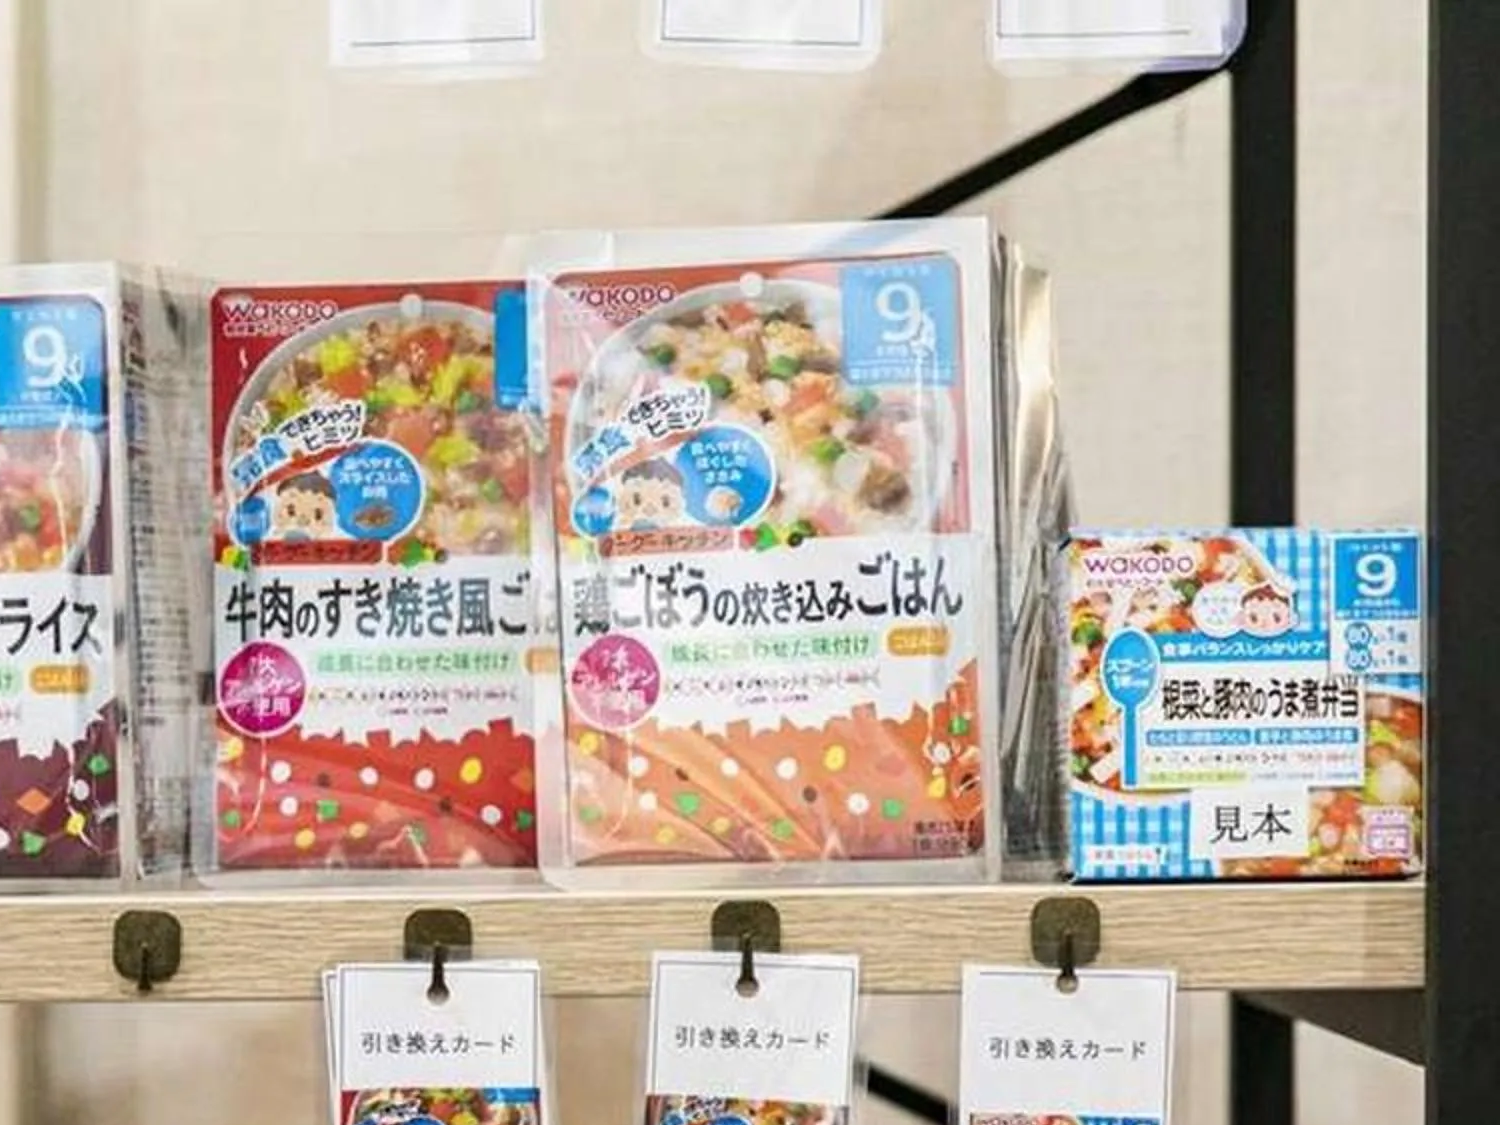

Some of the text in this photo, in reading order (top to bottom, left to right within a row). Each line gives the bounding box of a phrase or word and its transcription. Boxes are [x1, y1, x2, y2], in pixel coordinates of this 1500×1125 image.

[877, 282, 921, 344] 9
[23, 326, 65, 387] 9
[280, 406, 362, 440] できちゃう!
[573, 553, 963, 635] 鶏ごぼうの炊き込みごはん
[1355, 553, 1398, 597] 9
[225, 572, 557, 641] 牛肉のすき焼き風ご
[1162, 641, 1328, 658] 食事バランスしっかりケア
[1161, 674, 1360, 720] 根菜と豚肉のうま煮弁当
[1209, 803, 1293, 844] 見本
[361, 1031, 515, 1056] 引き換えカード
[675, 1026, 831, 1051] 引き換えカード
[988, 1037, 1147, 1061] 引き換えカード
